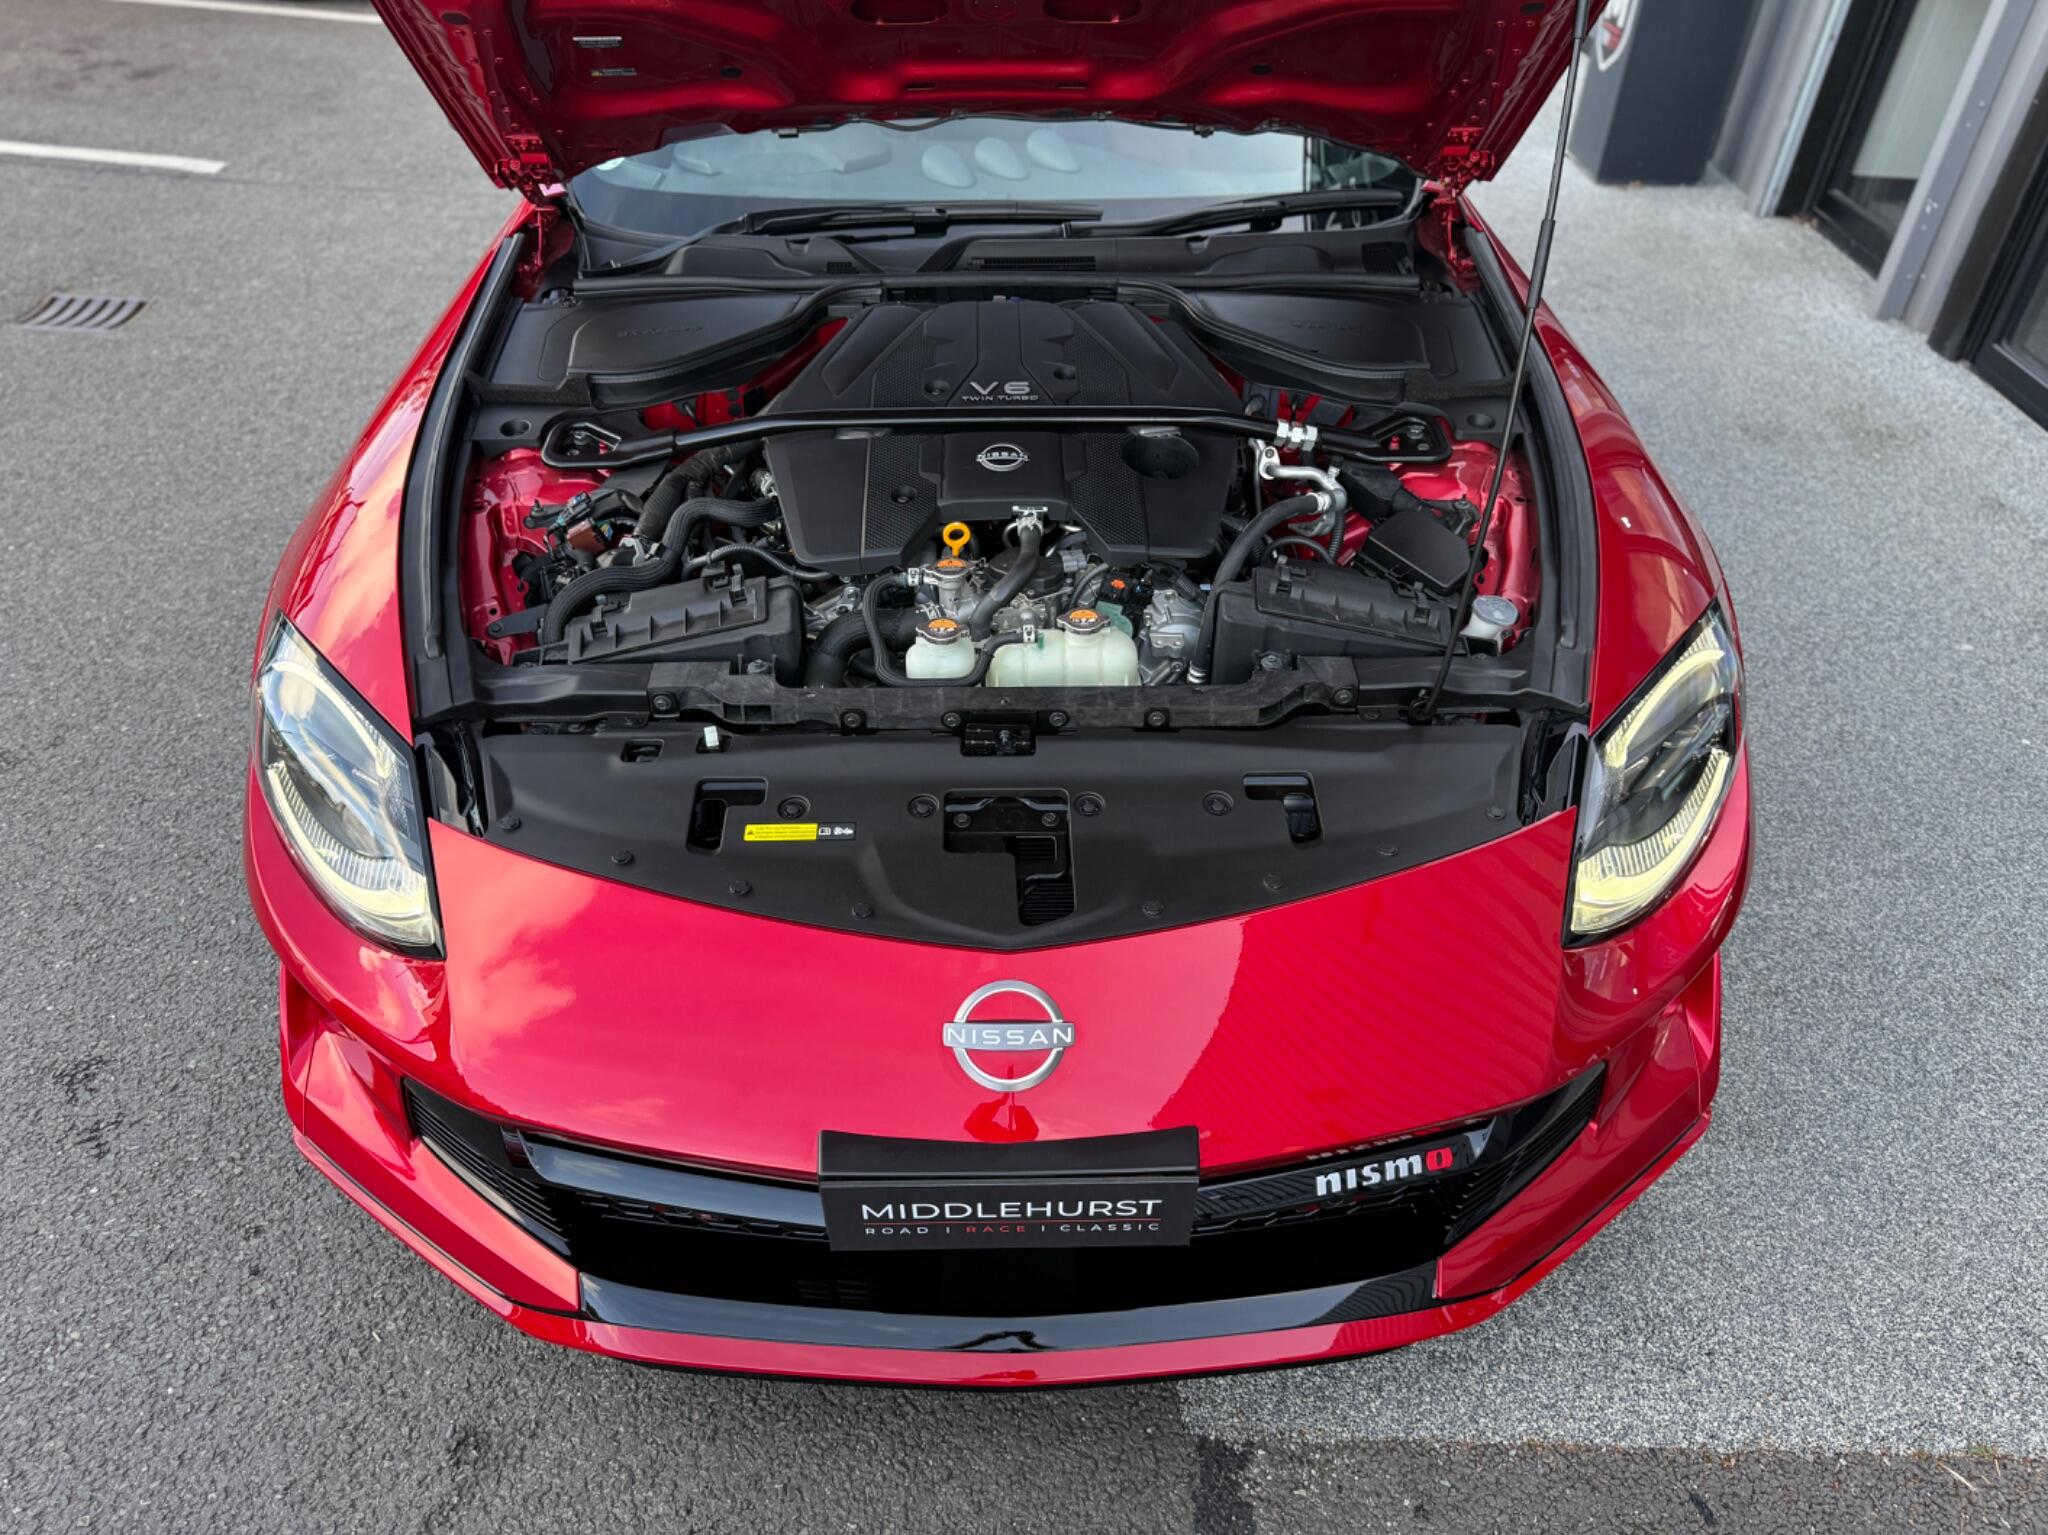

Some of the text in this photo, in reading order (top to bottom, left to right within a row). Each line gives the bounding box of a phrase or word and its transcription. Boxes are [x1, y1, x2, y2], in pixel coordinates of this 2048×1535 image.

[969, 381, 1031, 395] V6
[947, 1027, 1072, 1045] NISSAN
[1315, 1147, 1454, 1197] nismo
[861, 1199, 1163, 1220] MIDDLEHURST
[865, 1226, 929, 1235] ROAD
[966, 1225, 1026, 1233] RACE
[1060, 1223, 1159, 1232] CLASSIC
